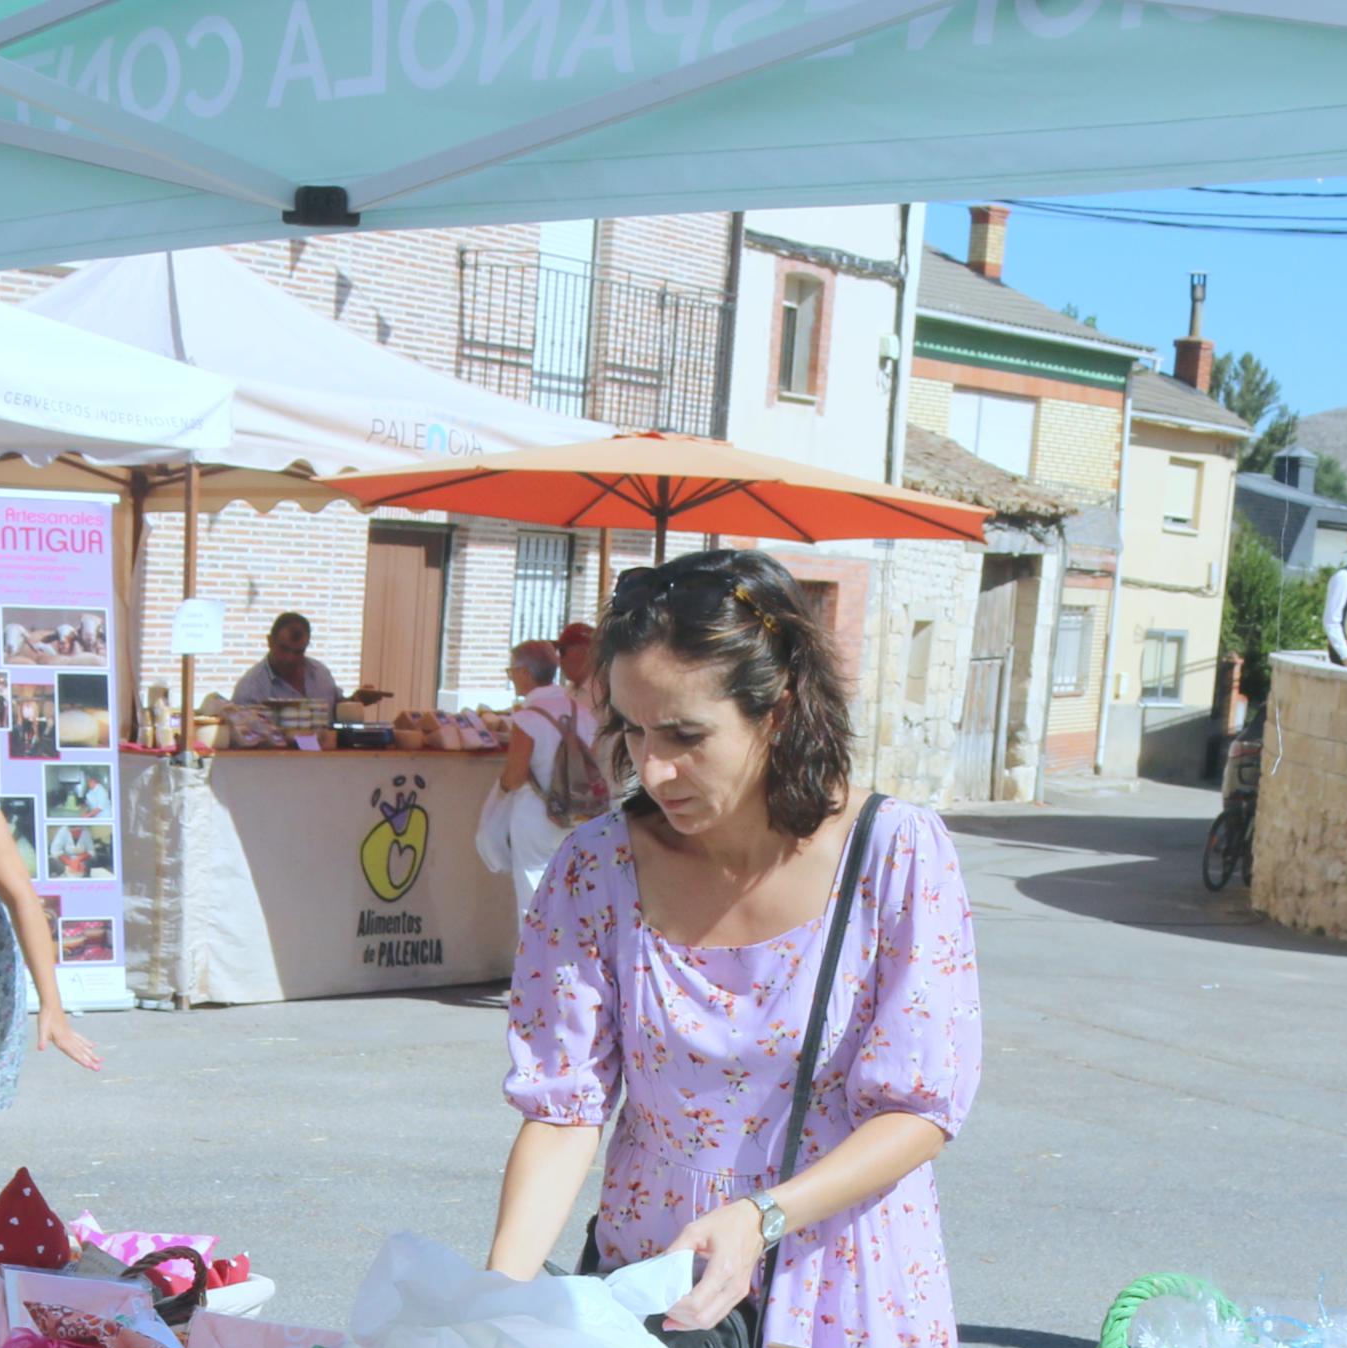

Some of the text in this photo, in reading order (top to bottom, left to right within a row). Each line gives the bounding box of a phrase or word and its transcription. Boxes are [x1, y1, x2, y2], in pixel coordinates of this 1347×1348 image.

[3, 391, 92, 420] CERVECEROS
[4, 507, 105, 527] Artesanales
[356, 909, 423, 938] Alimentos
[363, 938, 443, 968] de PALENCIA
